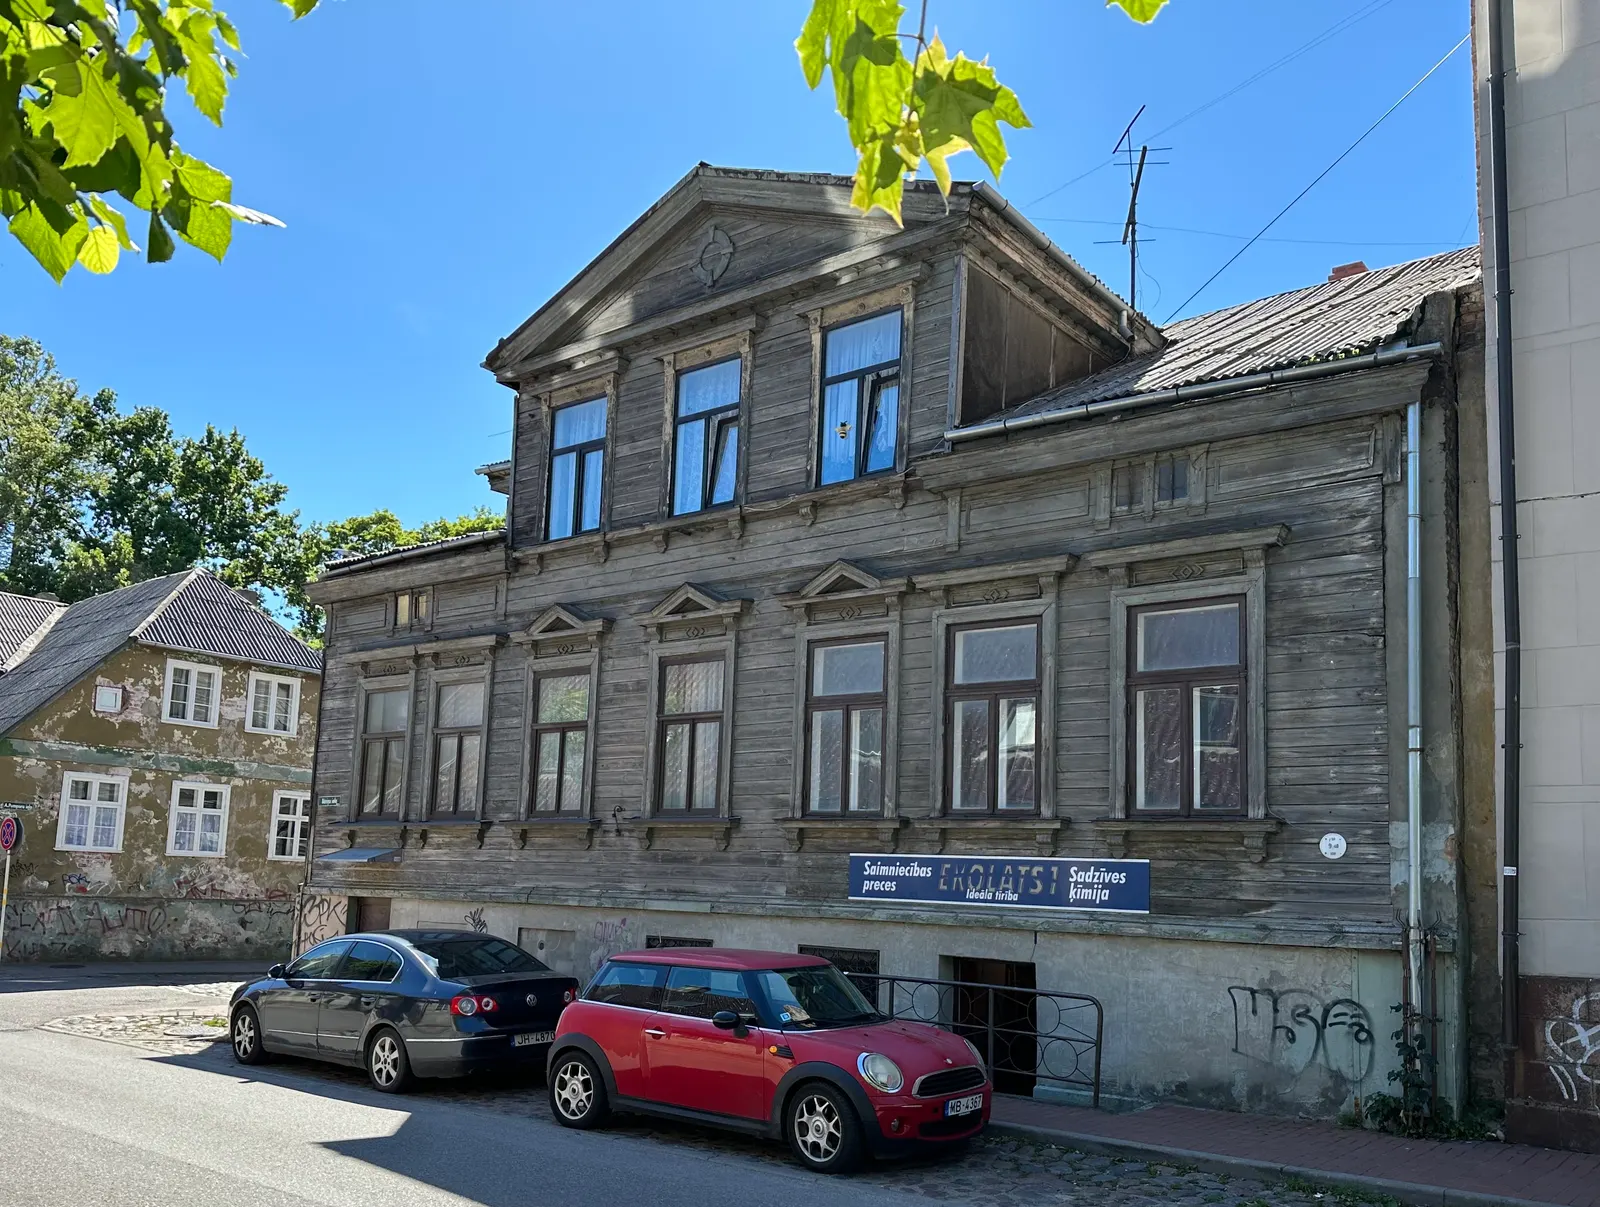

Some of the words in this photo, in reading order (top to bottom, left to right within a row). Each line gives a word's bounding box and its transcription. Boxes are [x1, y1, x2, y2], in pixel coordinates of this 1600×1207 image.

[863, 860, 932, 877] Saimniecības
[1069, 866, 1127, 884] Sadzīves
[862, 880, 897, 893] preces
[966, 888, 993, 900] Ideāla
[995, 889, 1019, 901] tīrība
[1068, 882, 1110, 904] ķīmija
[517, 1032, 555, 1044] JH-4870
[951, 1095, 982, 1113] MB-4367
